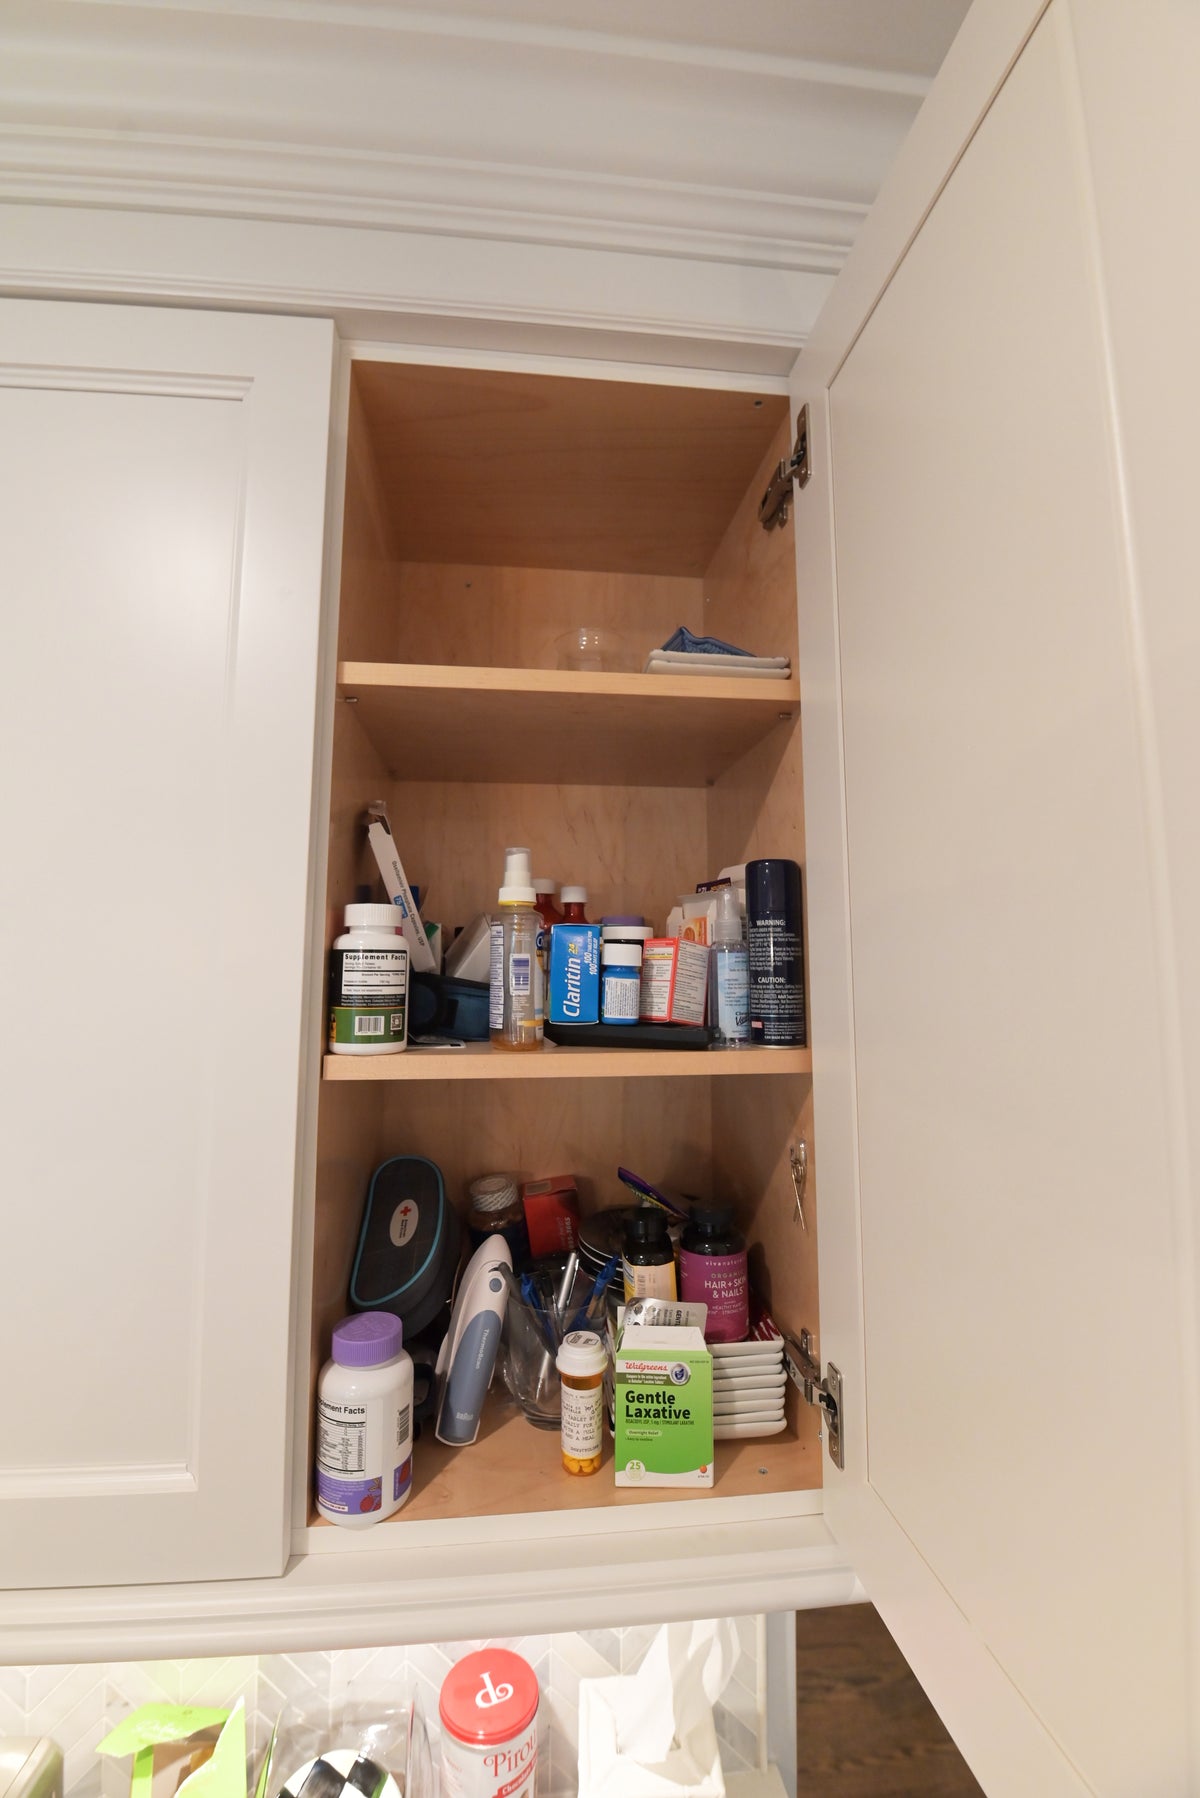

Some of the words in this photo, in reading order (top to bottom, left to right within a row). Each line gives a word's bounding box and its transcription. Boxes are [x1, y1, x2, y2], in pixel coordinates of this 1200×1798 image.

[584, 952, 592, 964] 100
[589, 964, 598, 975] 100
[757, 976, 787, 984] CAUTION:
[563, 957, 581, 1017] Claritin
[704, 1280, 727, 1289] HAIR
[712, 1290, 719, 1299] &
[721, 1286, 744, 1299] NAILS
[475, 1328, 490, 1370] ThermoScan
[625, 1361, 668, 1373] Walgreens
[626, 1390, 676, 1404] Gentle
[344, 1406, 366, 1415] Facts
[626, 1405, 691, 1419] Laxative
[630, 1462, 640, 1470] 25
